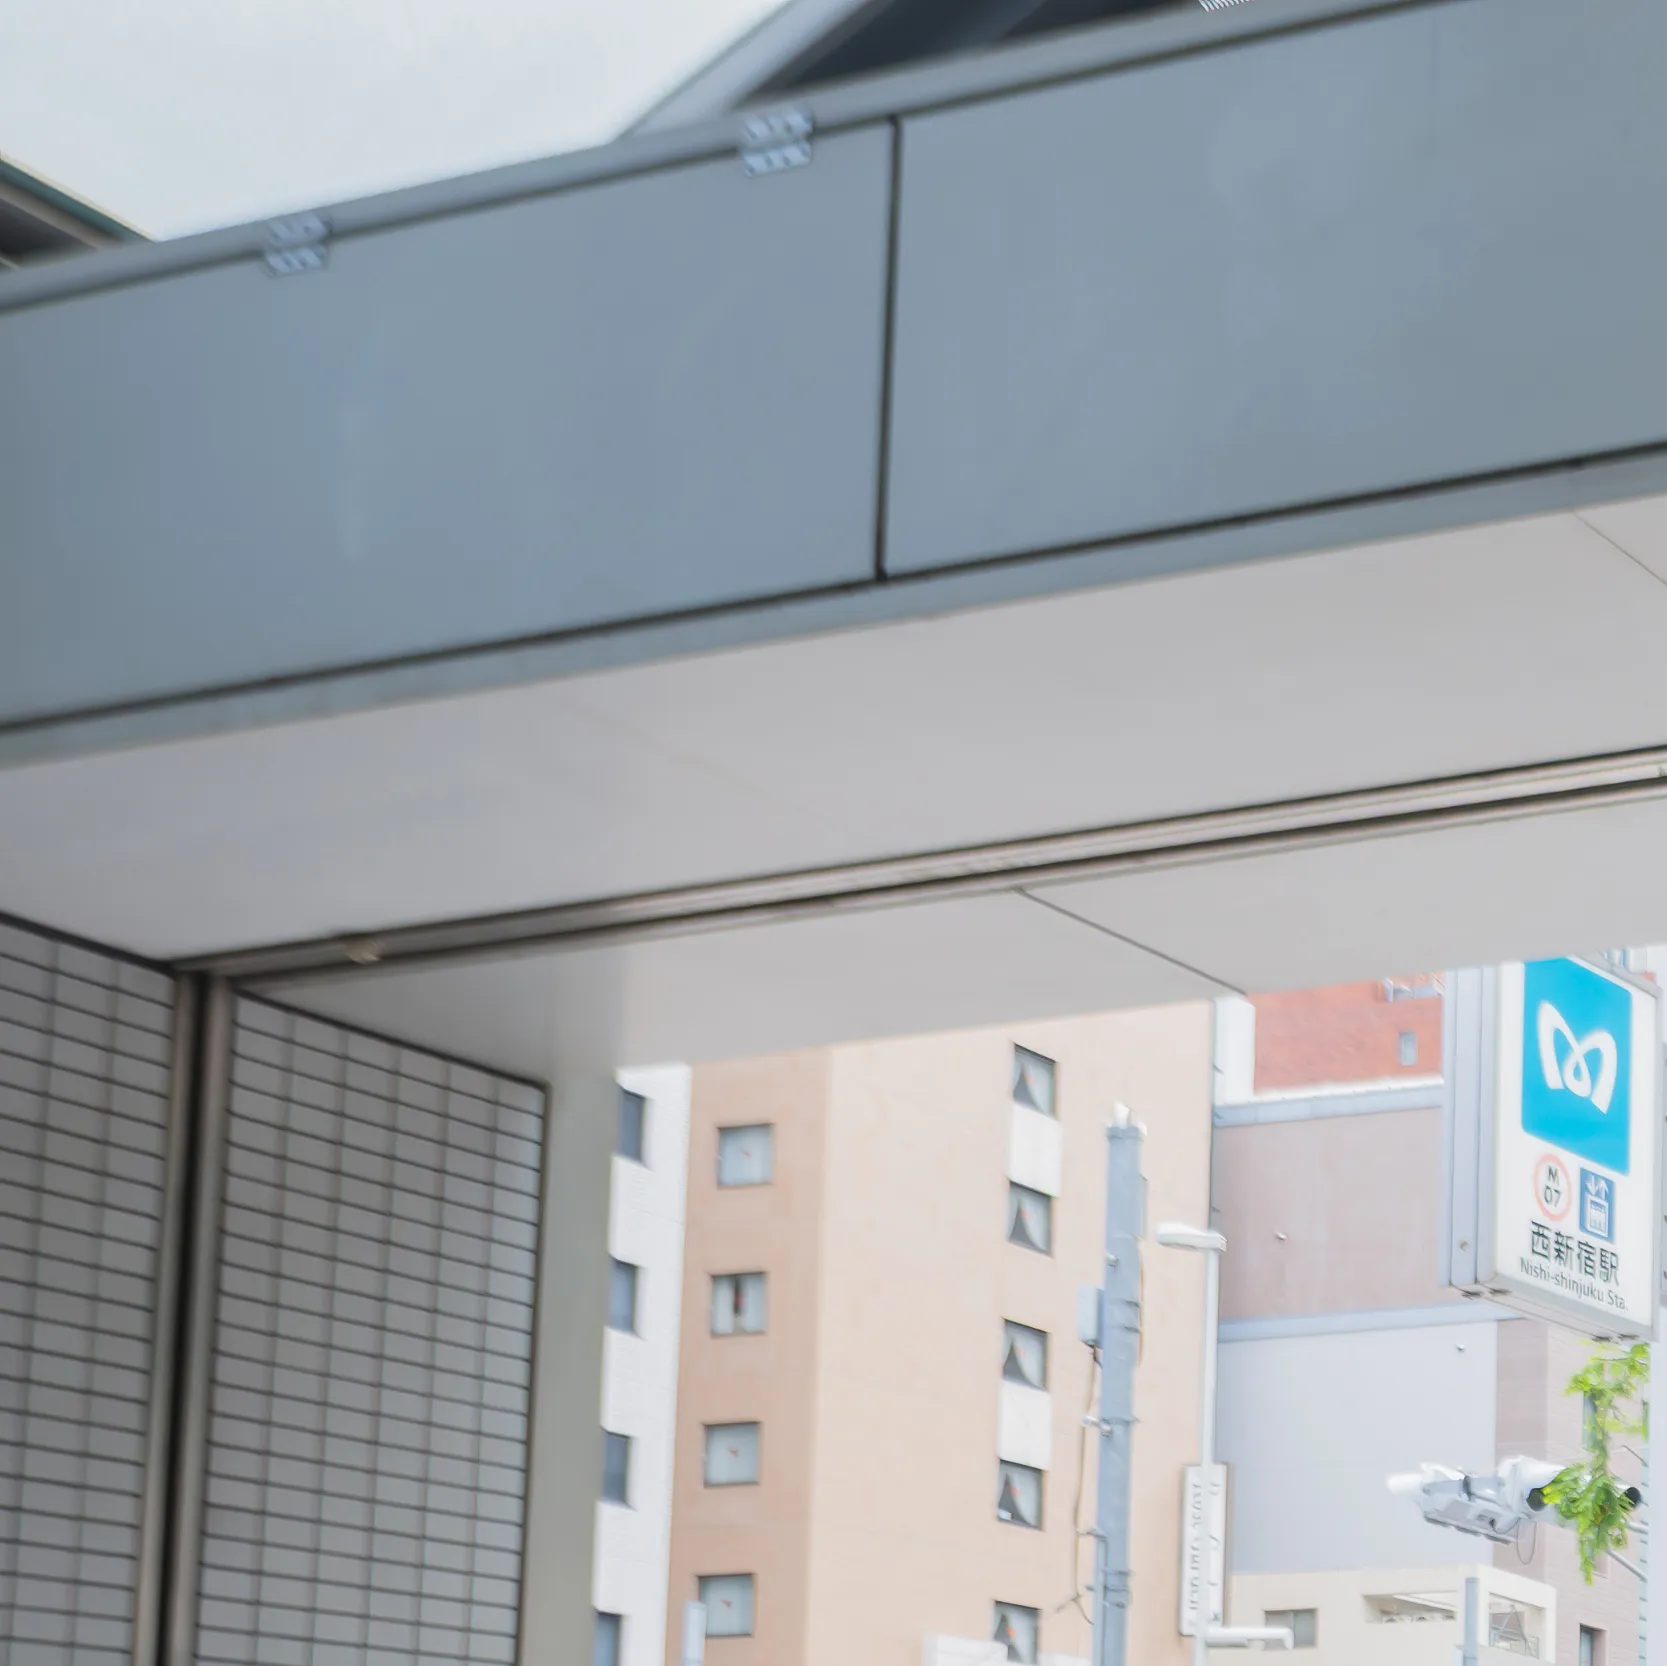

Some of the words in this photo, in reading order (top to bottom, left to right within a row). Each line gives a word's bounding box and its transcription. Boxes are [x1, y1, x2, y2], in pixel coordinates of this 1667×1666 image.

[1543, 1187, 1562, 1209] 07
[1530, 1219, 1620, 1287] 西新宿駅
[1519, 1256, 1605, 1304] Nishi-shinjuku
